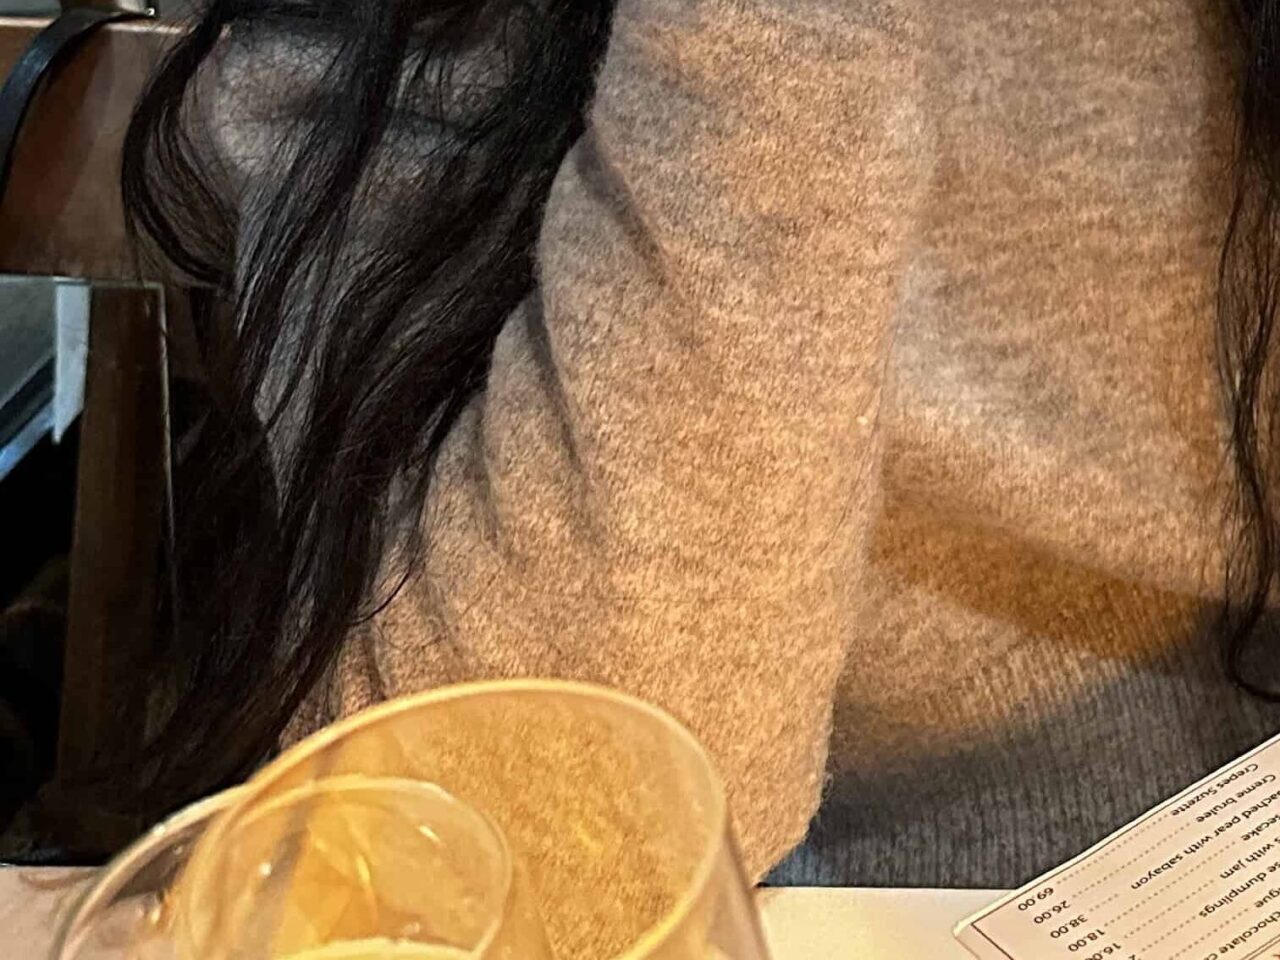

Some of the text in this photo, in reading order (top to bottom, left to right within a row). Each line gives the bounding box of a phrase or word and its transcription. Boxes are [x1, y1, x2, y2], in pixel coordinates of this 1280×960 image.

[1017, 763, 1259, 911] Crepes Suzette 69.00
[1213, 815, 1242, 837] pear
[1033, 774, 1277, 924] Creme brulee 26.00
[1183, 835, 1213, 855] with
[1245, 843, 1275, 863] with
[1130, 854, 1184, 890] sabayon
[1219, 859, 1247, 879] jam
[1198, 872, 1267, 918] dumplings
[1050, 914, 1088, 939] 38.00
[1067, 929, 1105, 952] 18.00
